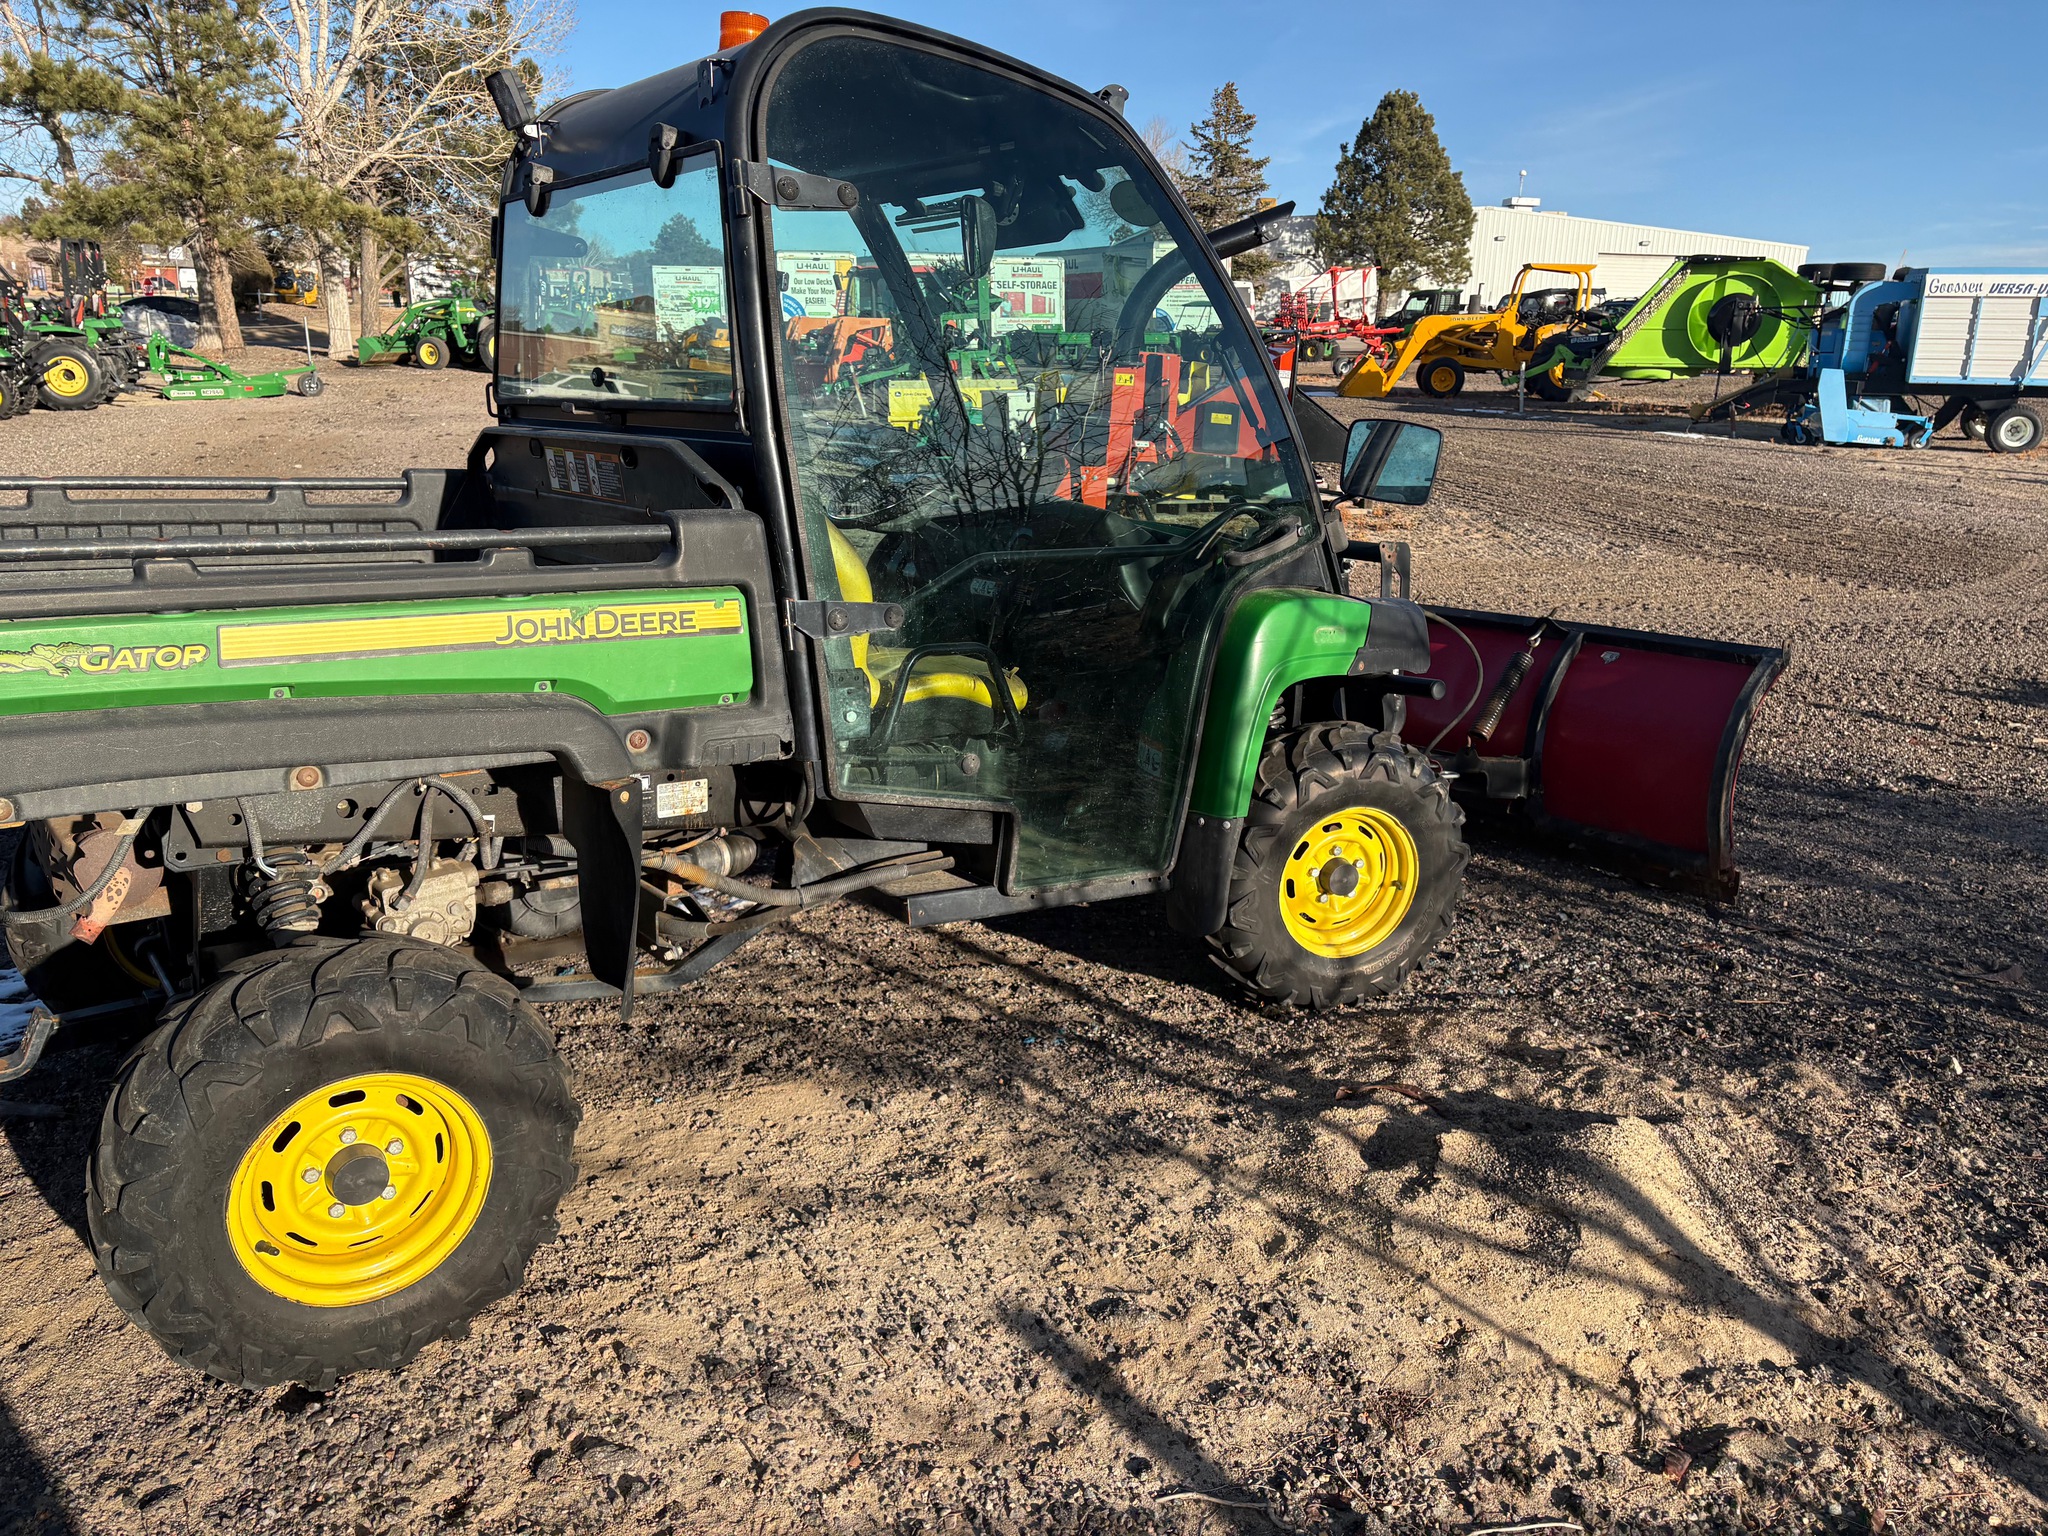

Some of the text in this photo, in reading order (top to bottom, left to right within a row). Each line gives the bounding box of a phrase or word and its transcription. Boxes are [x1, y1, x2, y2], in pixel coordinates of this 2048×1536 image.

[796, 262, 829, 270] U-HAUL
[996, 280, 1058, 290] SELF-STORAGE
[1929, 278, 1983, 294] Goossen
[807, 287, 820, 295] Your
[820, 287, 835, 295] Move
[805, 297, 827, 305] EASIER!
[495, 610, 697, 643] JOHN DEERE
[78, 645, 208, 673] GATOR
